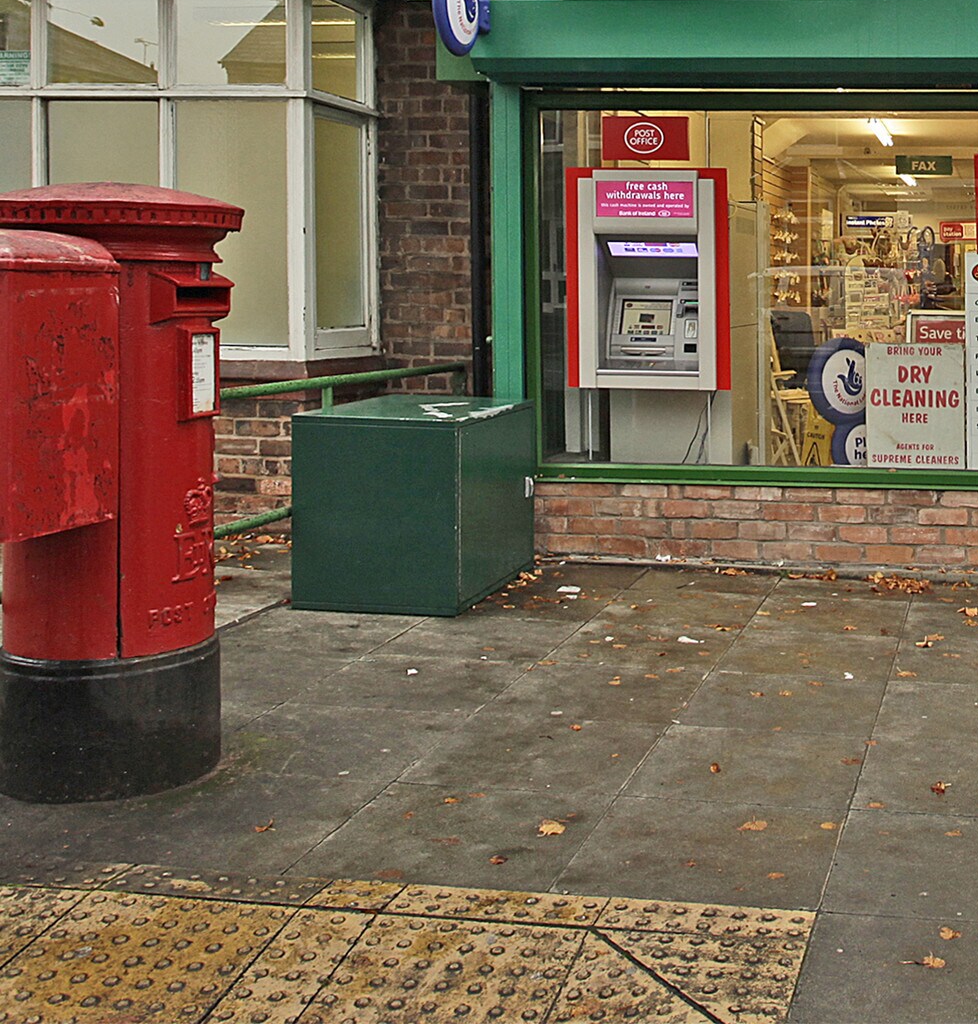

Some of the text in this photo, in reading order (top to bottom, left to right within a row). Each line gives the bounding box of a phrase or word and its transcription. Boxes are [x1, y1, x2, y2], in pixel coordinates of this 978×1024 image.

[634, 129, 655, 137] POST
[629, 137, 658, 146] OFFICE
[911, 161, 936, 171] FAX
[626, 182, 668, 191] free cash
[606, 191, 685, 200] withdrawals here
[919, 326, 952, 339] Save
[887, 346, 942, 356] BRING YOUR
[898, 365, 933, 384] DRY
[870, 389, 960, 408] CLEANING
[902, 413, 928, 424] HERE
[922, 443, 934, 451] FOR
[872, 454, 959, 465] SUPREME CLEANERS
